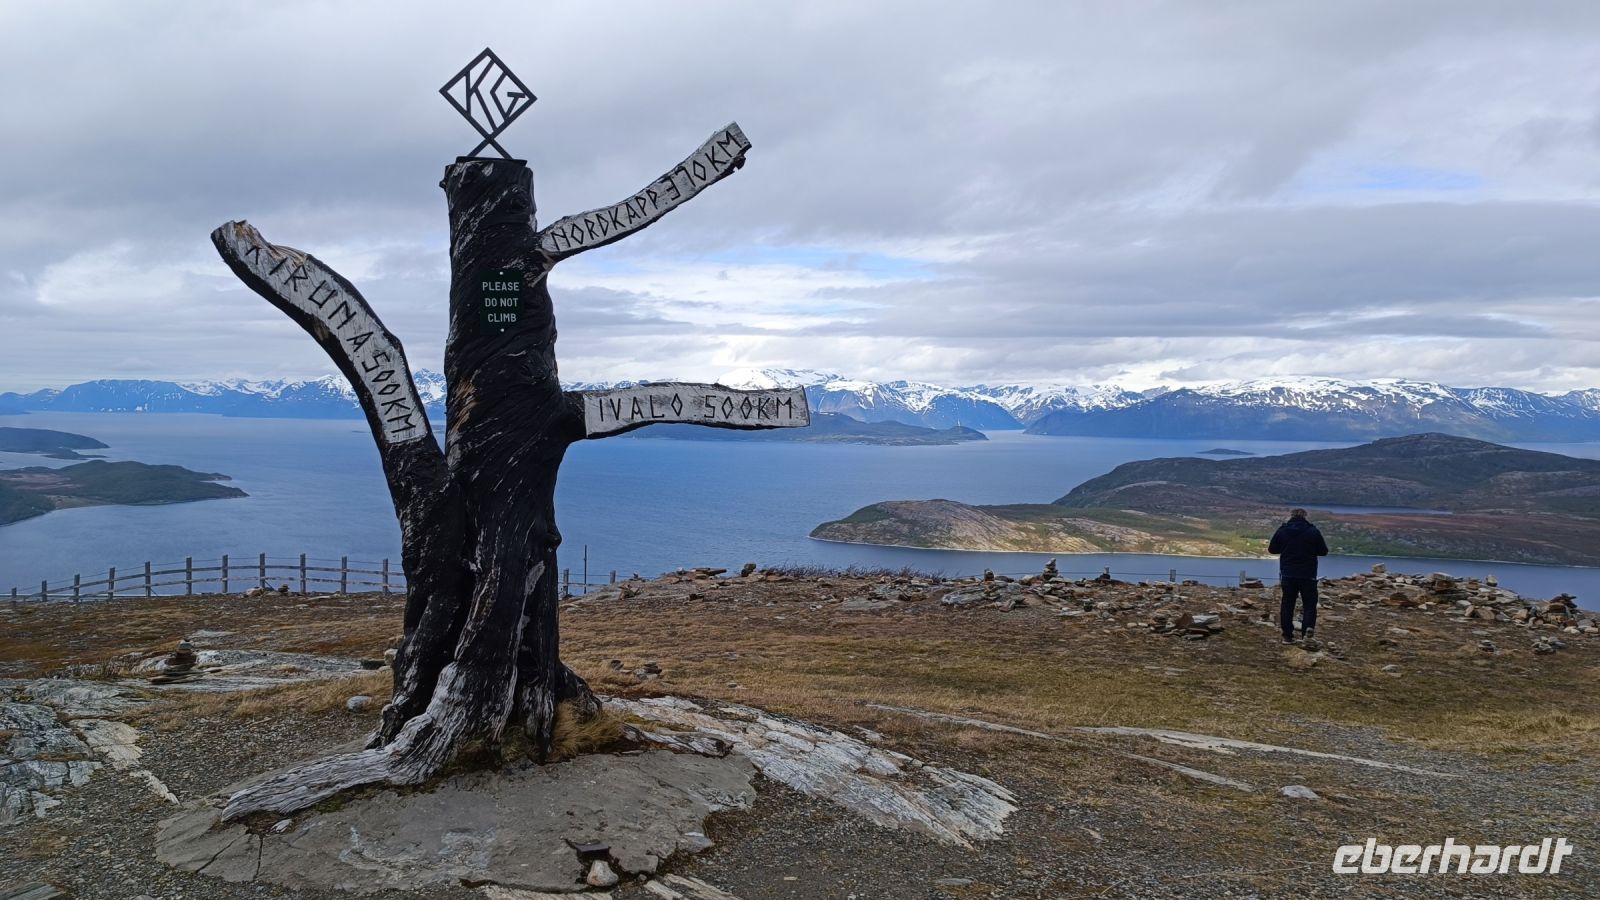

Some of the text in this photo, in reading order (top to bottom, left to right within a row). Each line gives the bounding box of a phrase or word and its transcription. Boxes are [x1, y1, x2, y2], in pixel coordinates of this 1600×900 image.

[482, 281, 520, 291] PLEASE
[484, 297, 519, 307] DO NOT
[487, 313, 517, 323] CLIMB
[361, 351, 417, 434] 500KM
[703, 394, 793, 420] 500KM
